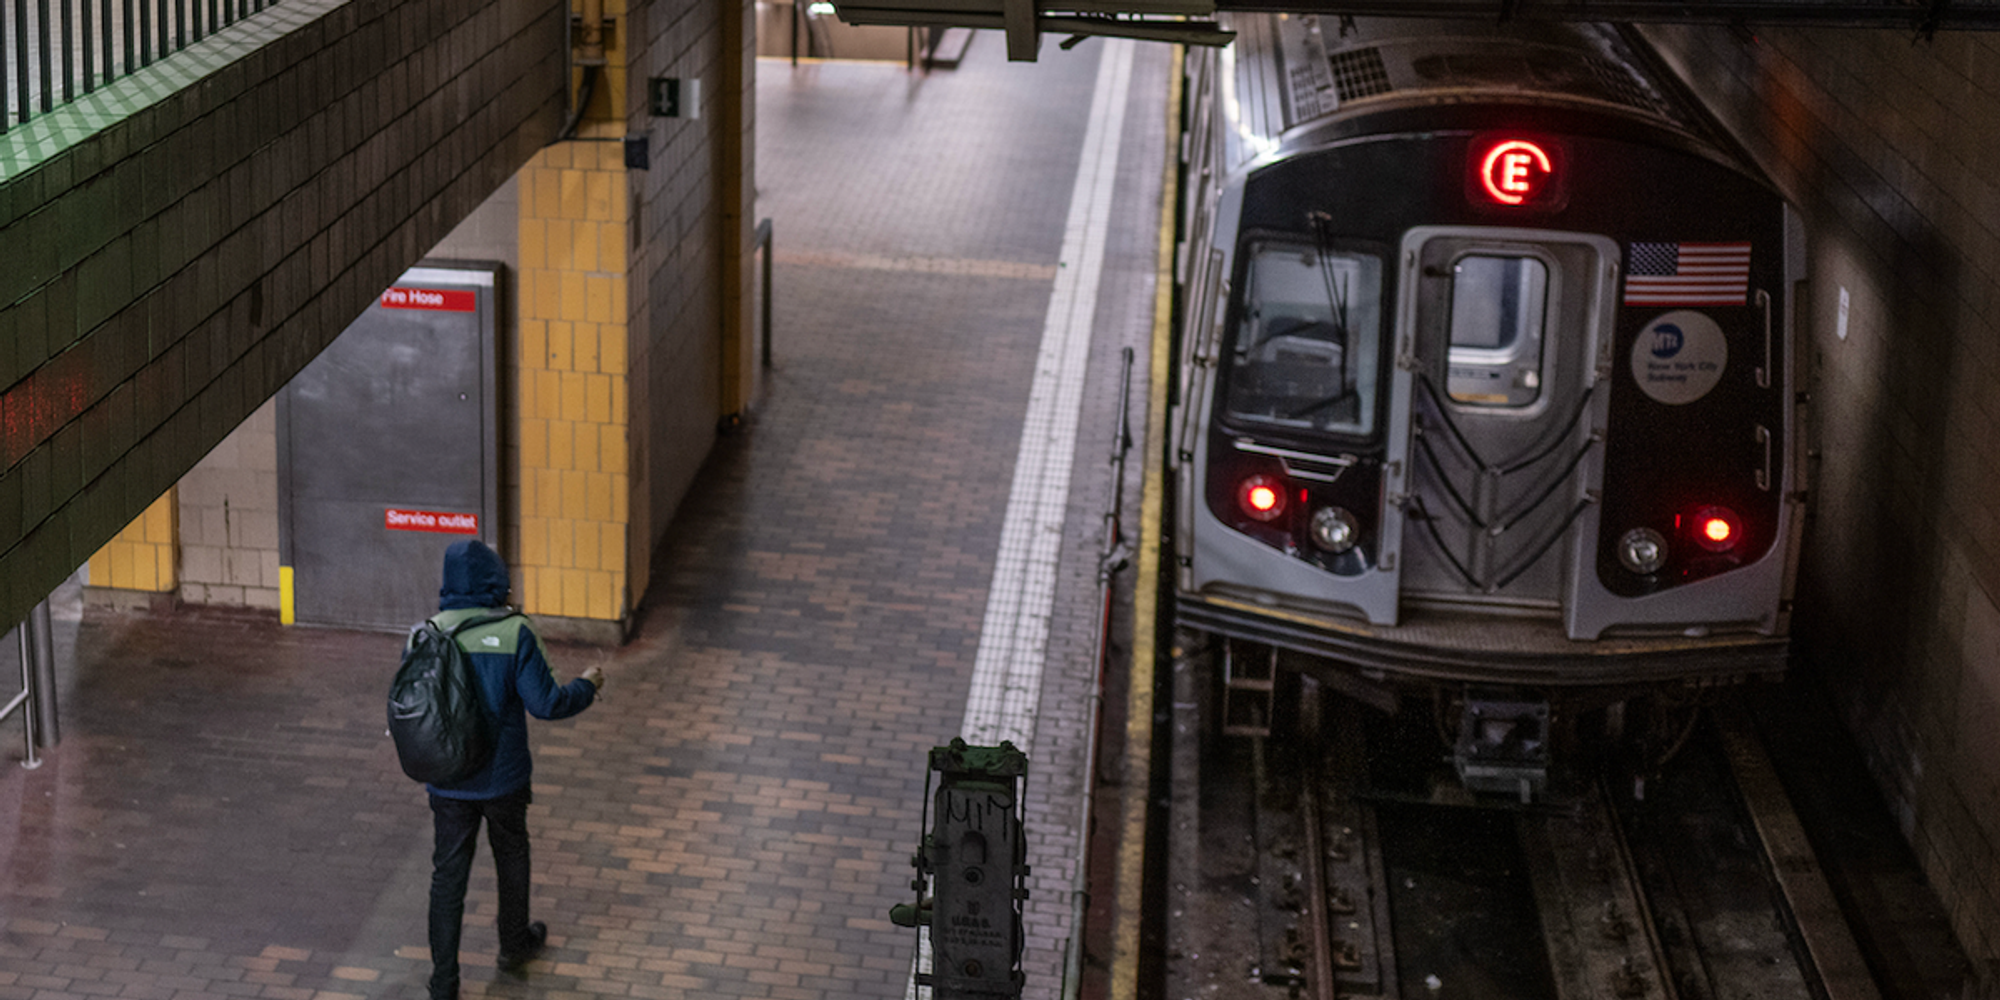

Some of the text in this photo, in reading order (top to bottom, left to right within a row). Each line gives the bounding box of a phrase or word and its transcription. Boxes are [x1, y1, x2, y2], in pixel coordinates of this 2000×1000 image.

[1503, 153, 1531, 191] E
[382, 288, 444, 306] Fire Hose
[1648, 361, 1718, 373] New York City
[1647, 372, 1687, 384] Subway
[388, 510, 476, 529] Service outlet
